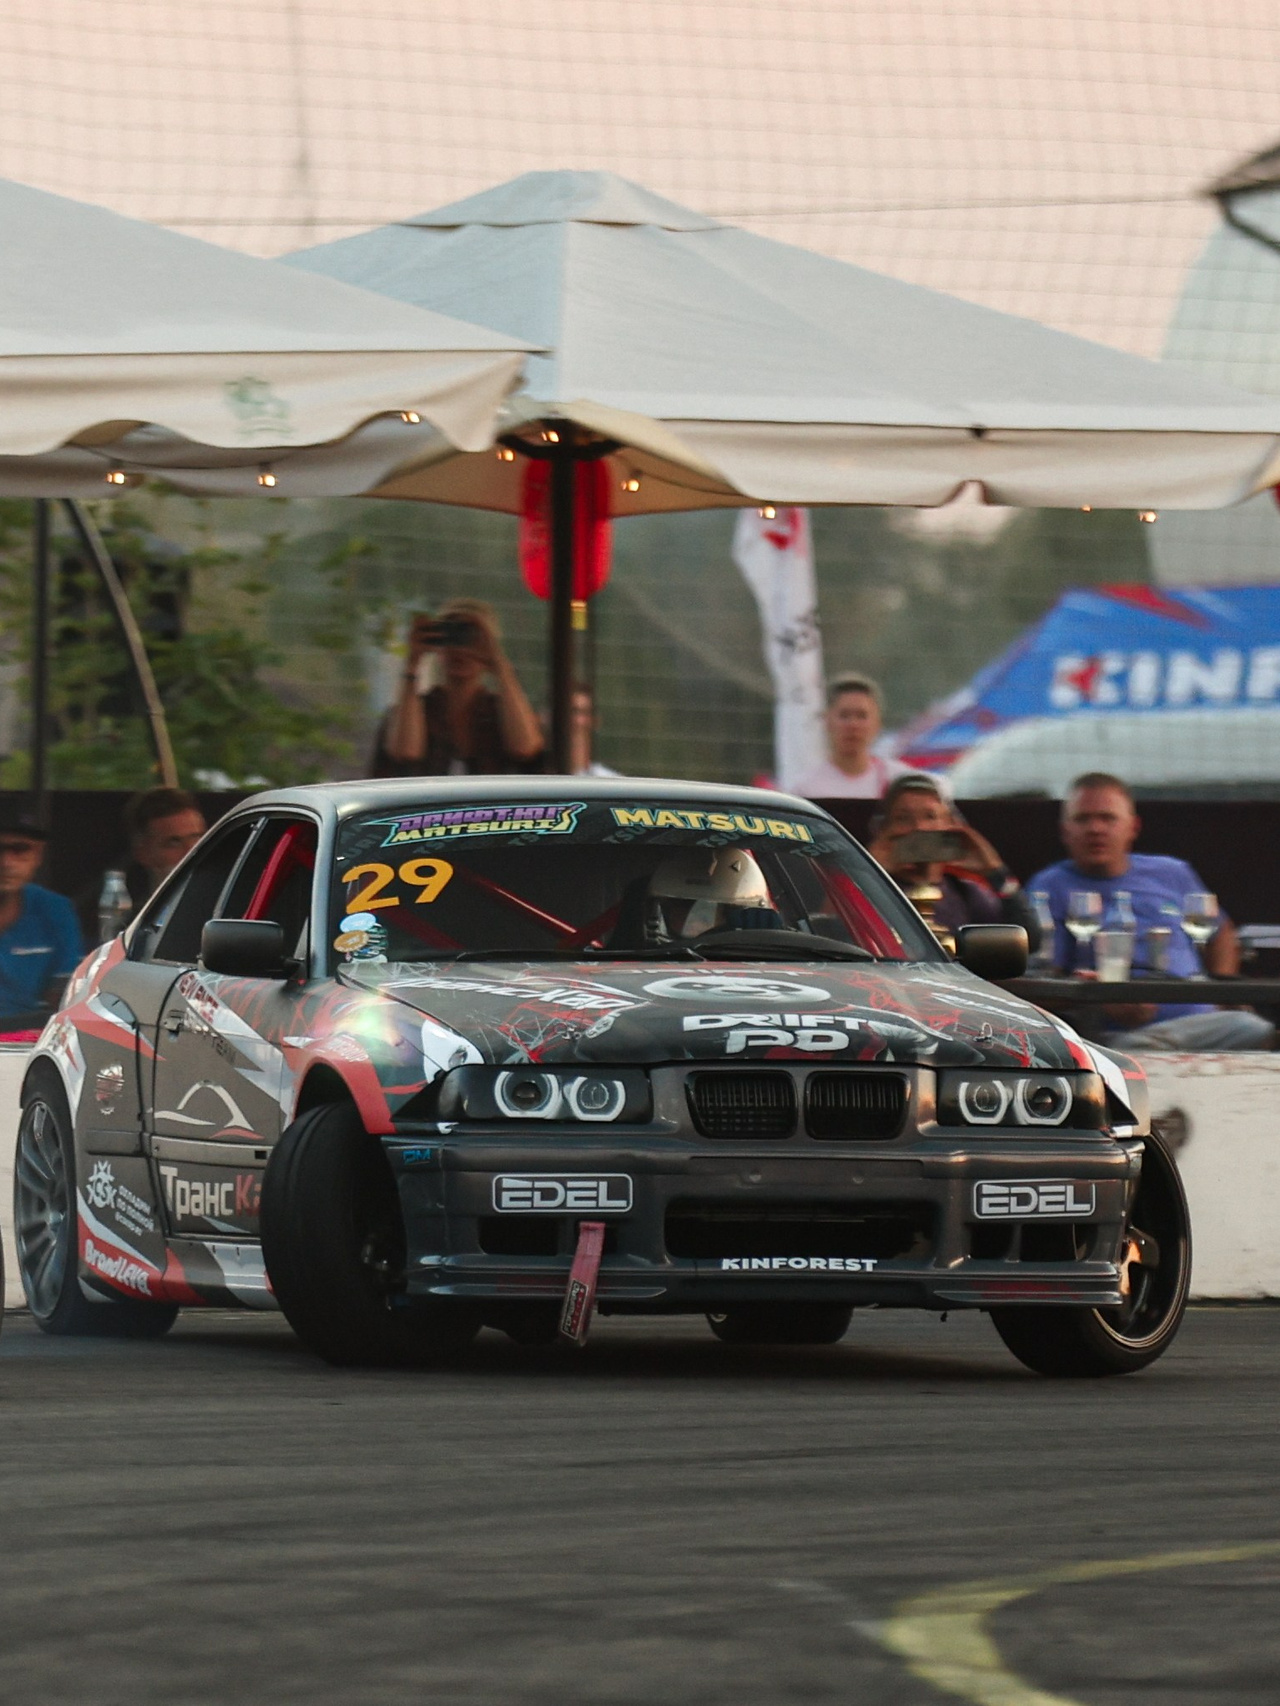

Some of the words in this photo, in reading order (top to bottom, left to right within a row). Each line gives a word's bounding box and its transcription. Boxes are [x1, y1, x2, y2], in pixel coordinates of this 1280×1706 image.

[391, 819, 557, 843] MATSURI
[610, 808, 815, 844] MATSURI
[341, 858, 454, 914] 29
[683, 1014, 868, 1032] DRIFT
[501, 1178, 628, 1208] EDEL
[981, 1184, 1091, 1214] EDEL
[721, 1257, 878, 1272] KINFOREST
